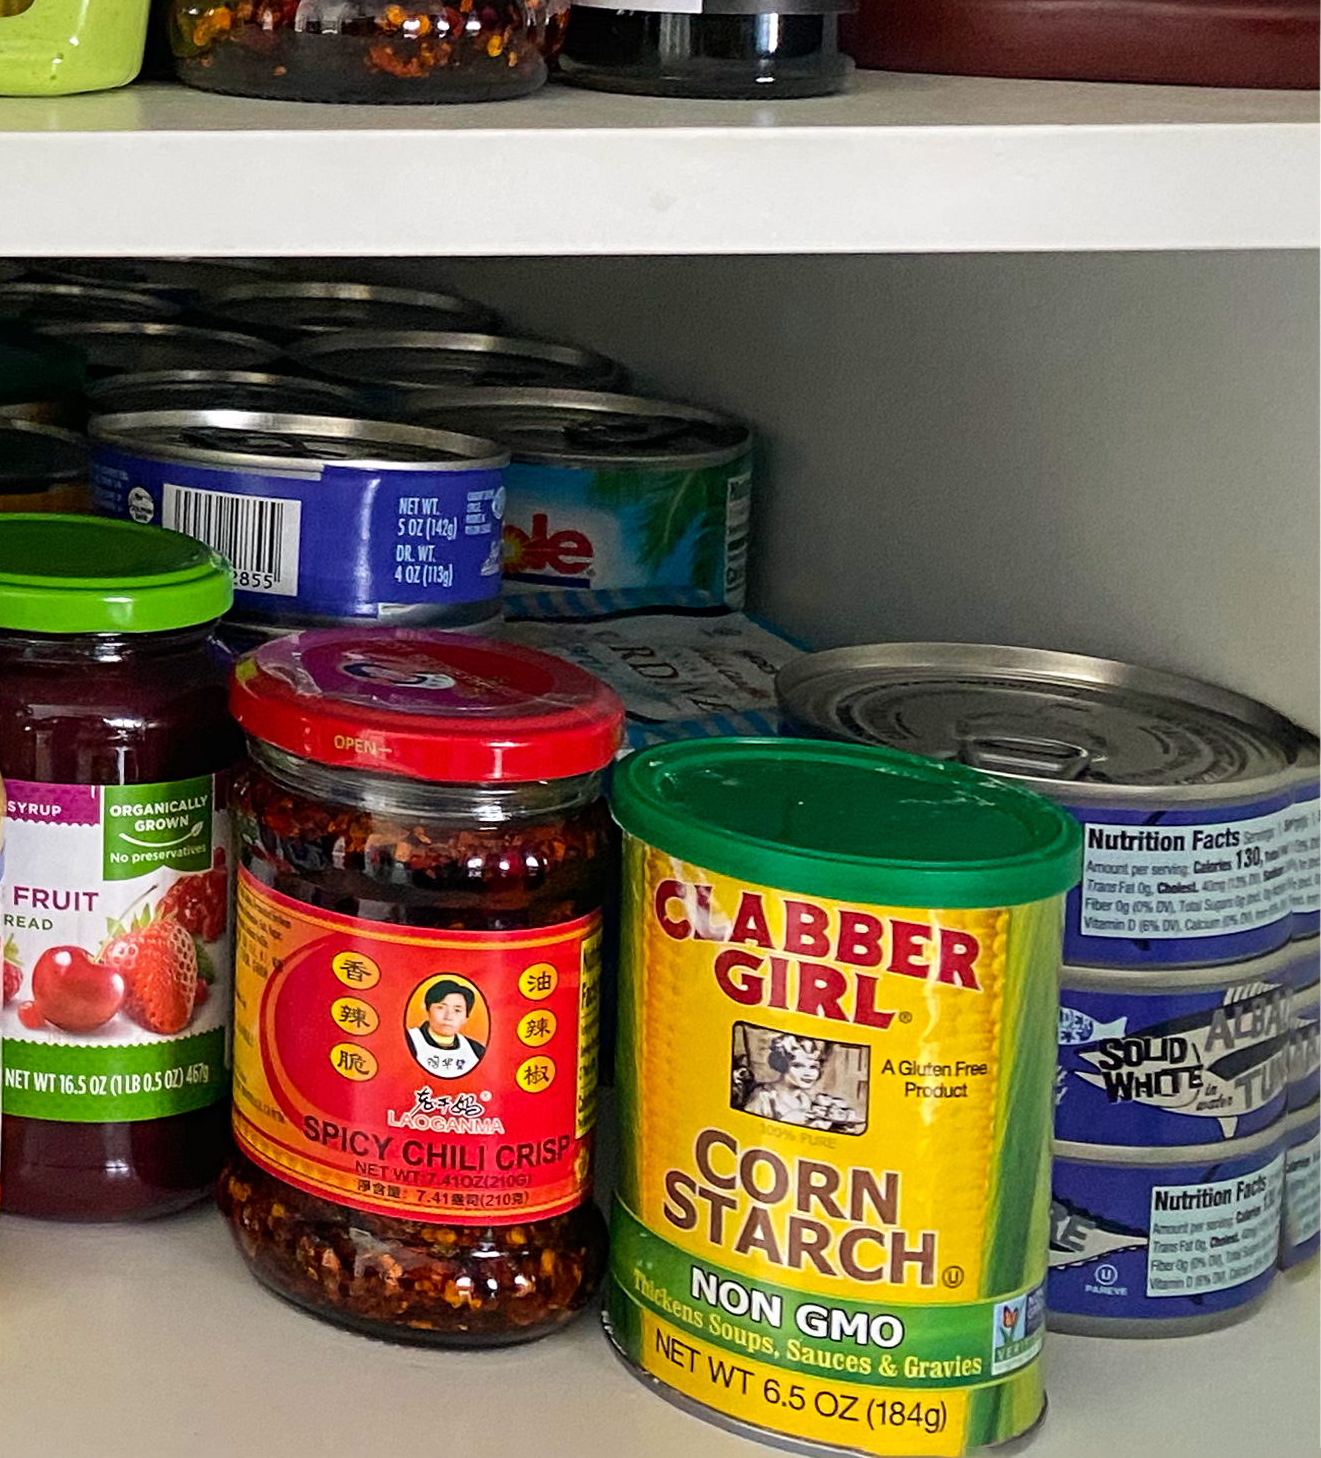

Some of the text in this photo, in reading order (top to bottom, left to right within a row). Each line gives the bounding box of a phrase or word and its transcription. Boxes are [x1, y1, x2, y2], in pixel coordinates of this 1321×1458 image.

[397, 516, 457, 540] 5 OZ (142g)
[110, 796, 208, 816] ORGANICALLY
[134, 815, 189, 831] GROWN
[110, 844, 206, 865] No preservatives
[1088, 828, 1239, 852] Nutrition Facts
[13, 885, 99, 912] FRUIT
[654, 879, 981, 991] CLABBER
[714, 949, 896, 1030] GIRL
[1099, 1037, 1189, 1069] SOLID
[881, 1060, 987, 1077] A Gluten Free
[904, 1081, 968, 1099] Product
[1104, 1065, 1203, 1102] WHITE
[388, 1110, 505, 1135] LAOGANMA
[303, 1115, 572, 1173] SPICY CHILI CRISP
[695, 1129, 899, 1225] CORN
[1154, 1186, 1231, 1212] Nutrition
[664, 1171, 937, 1287] STARCH
[691, 1266, 904, 1347] NON GMO
[633, 1270, 982, 1379] Thickens Soups, Sauces & Gravies
[656, 1328, 948, 1433] NET WT 6.5 OZ (184g)
